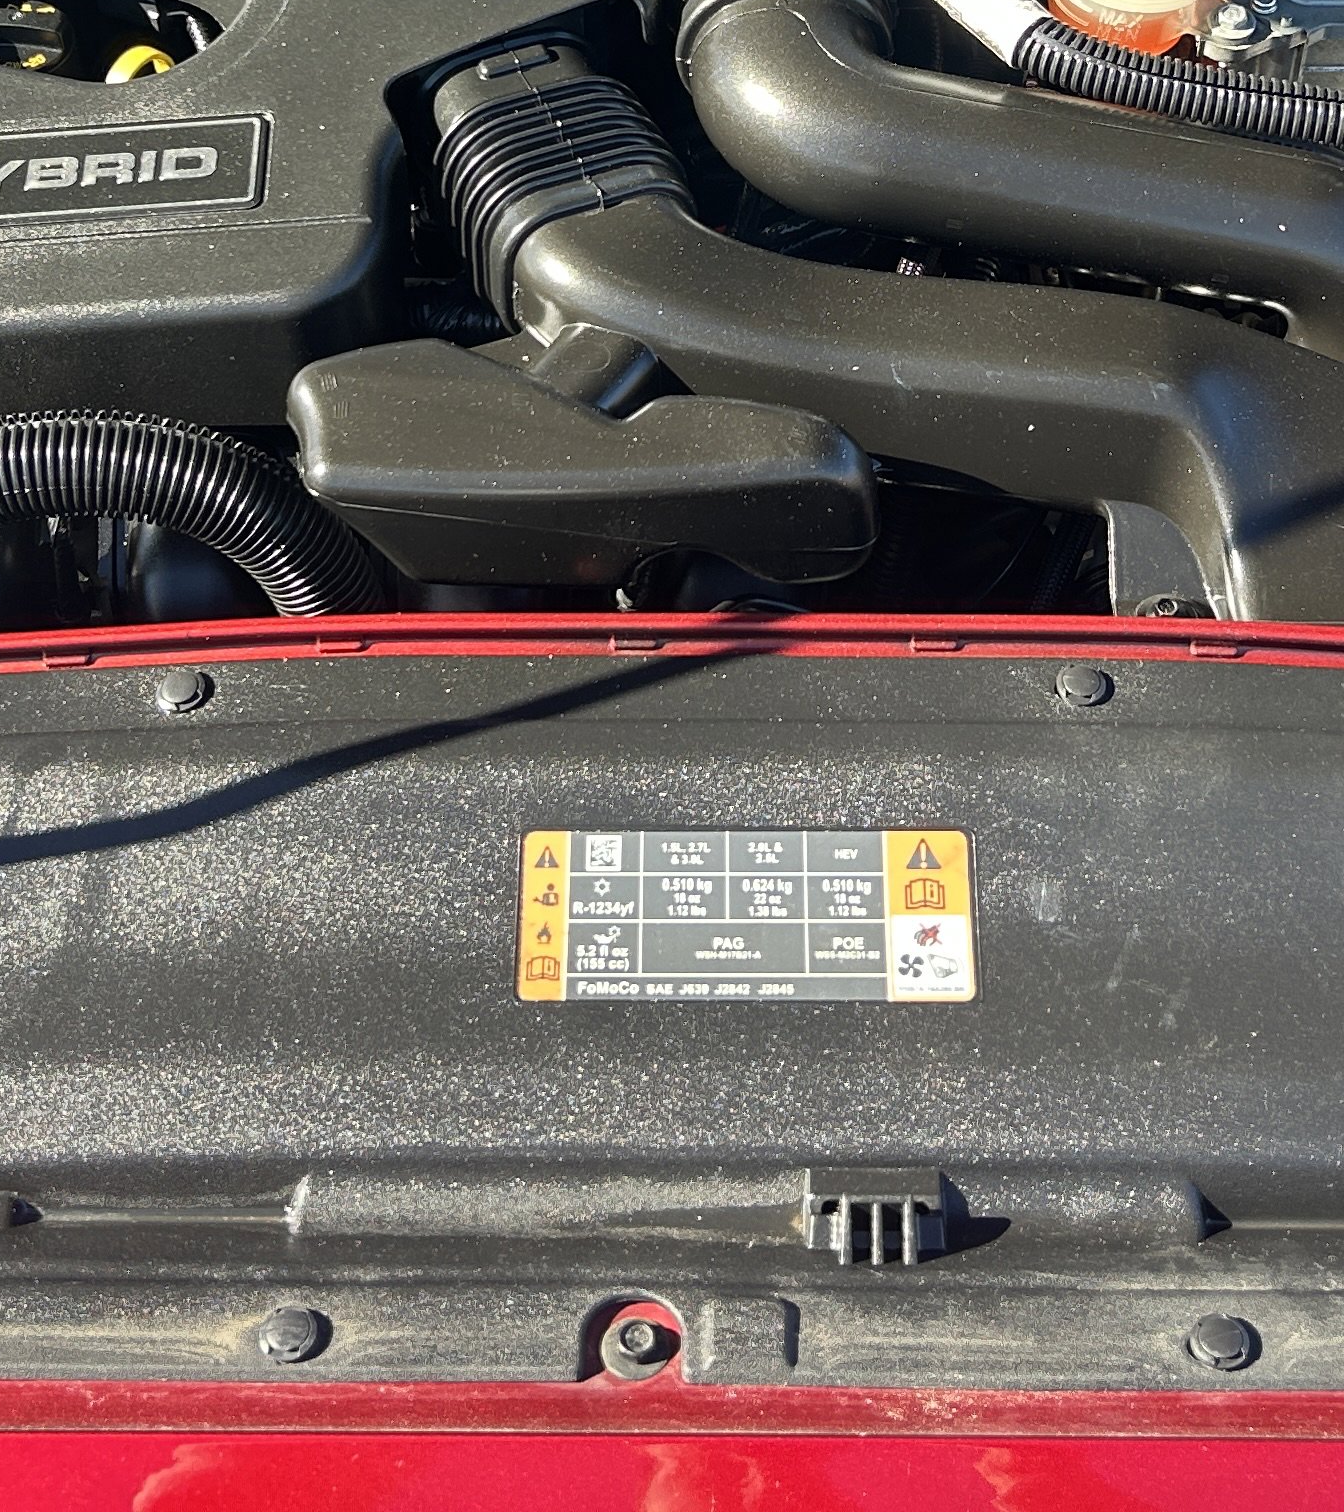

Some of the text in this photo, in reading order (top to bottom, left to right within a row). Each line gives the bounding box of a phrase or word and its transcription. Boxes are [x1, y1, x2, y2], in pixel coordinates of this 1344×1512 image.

[1099, 9, 1144, 28] MAX
[688, 842, 712, 854] 2.7L
[834, 848, 858, 860] HEV
[661, 878, 713, 894] 0.510 kg
[742, 879, 793, 896] 0.624 kg
[822, 879, 872, 895] 0.510 kg
[687, 895, 702, 904] oz
[754, 893, 782, 904] 22 oz
[848, 895, 861, 904] oz
[573, 901, 635, 917] R-1234yf
[666, 905, 707, 916] 1.12 lbs
[771, 906, 788, 917] lbs
[828, 906, 867, 917] 1.12 lbs
[712, 936, 745, 950] PAG
[832, 936, 865, 950] POE
[576, 945, 629, 958] 5.2 fl oz
[576, 958, 630, 971] (155 cc)
[577, 981, 640, 995] FoMoCo
[645, 983, 674, 996] SAE
